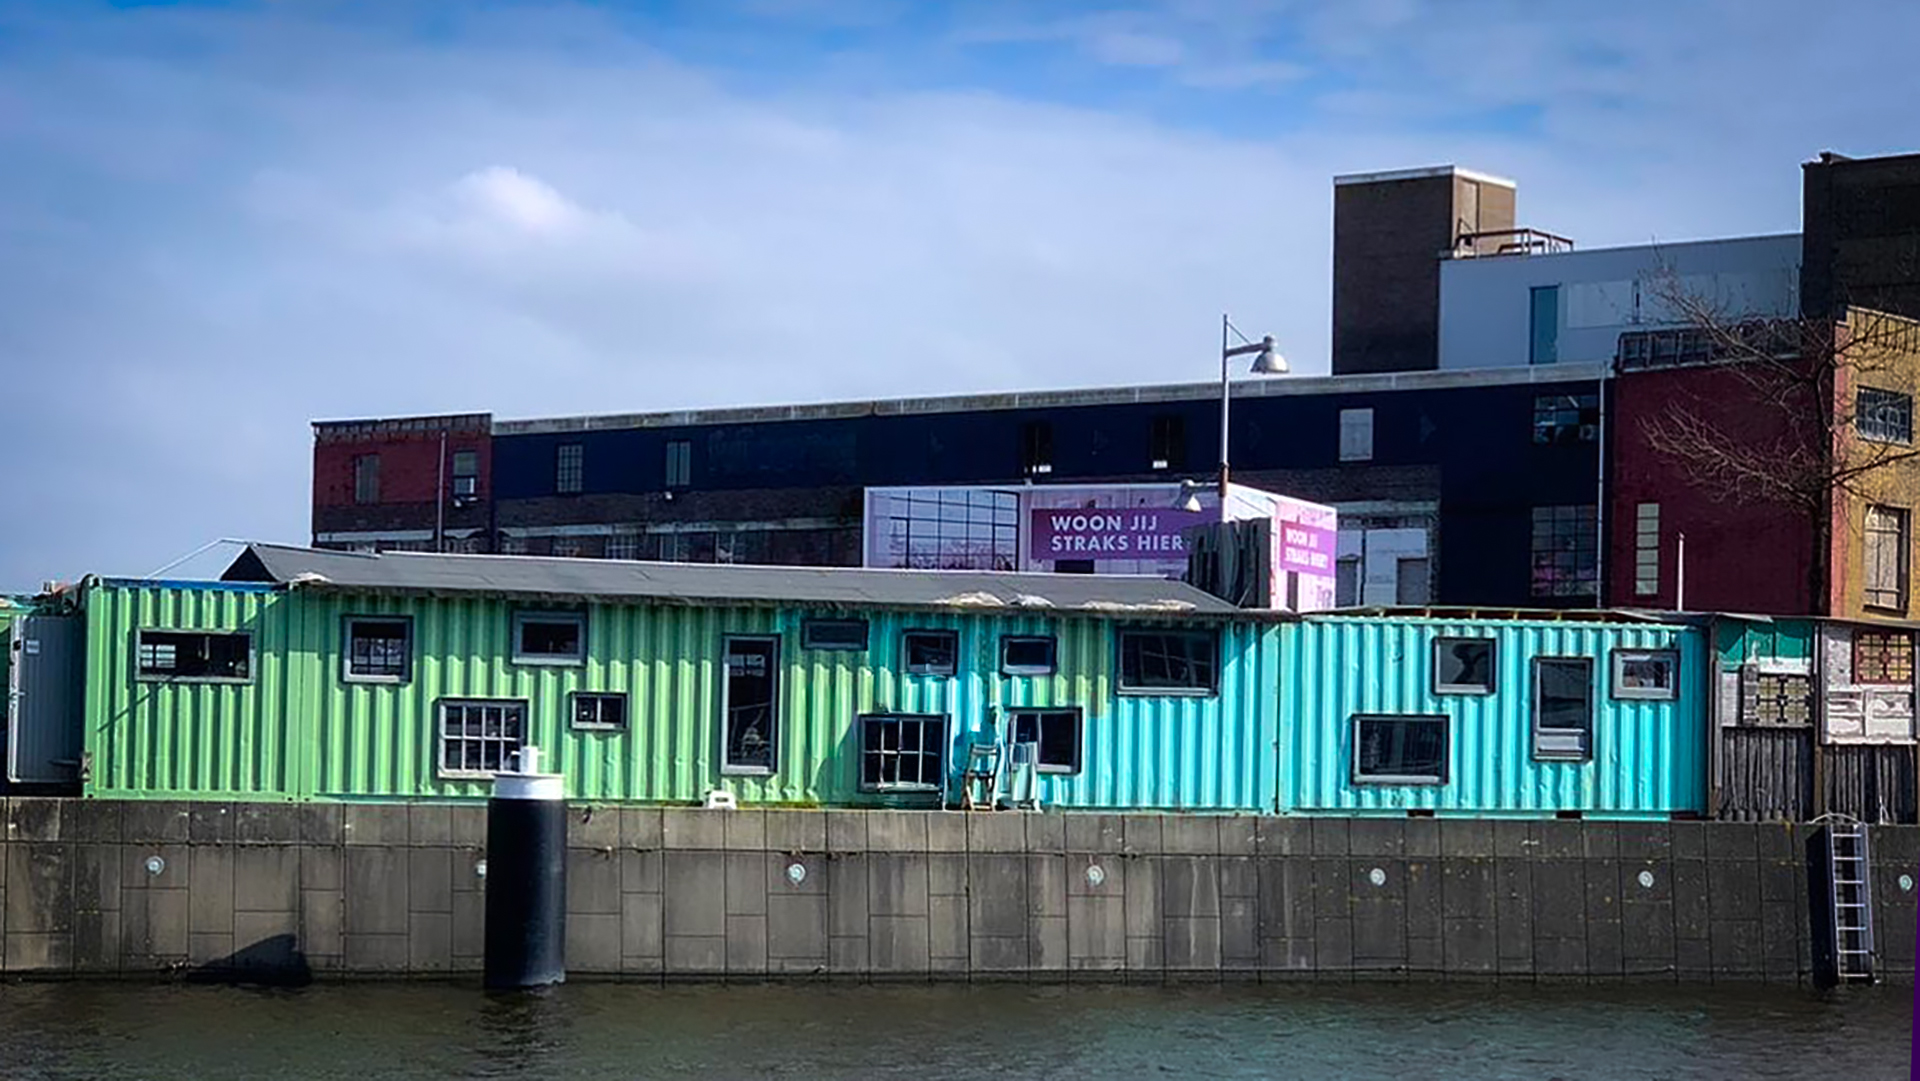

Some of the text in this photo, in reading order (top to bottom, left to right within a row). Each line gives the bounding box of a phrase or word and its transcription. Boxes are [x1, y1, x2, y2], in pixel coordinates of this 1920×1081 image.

[1051, 515, 1157, 531] WOON JIJ
[1051, 535, 1128, 551] STRAKS
